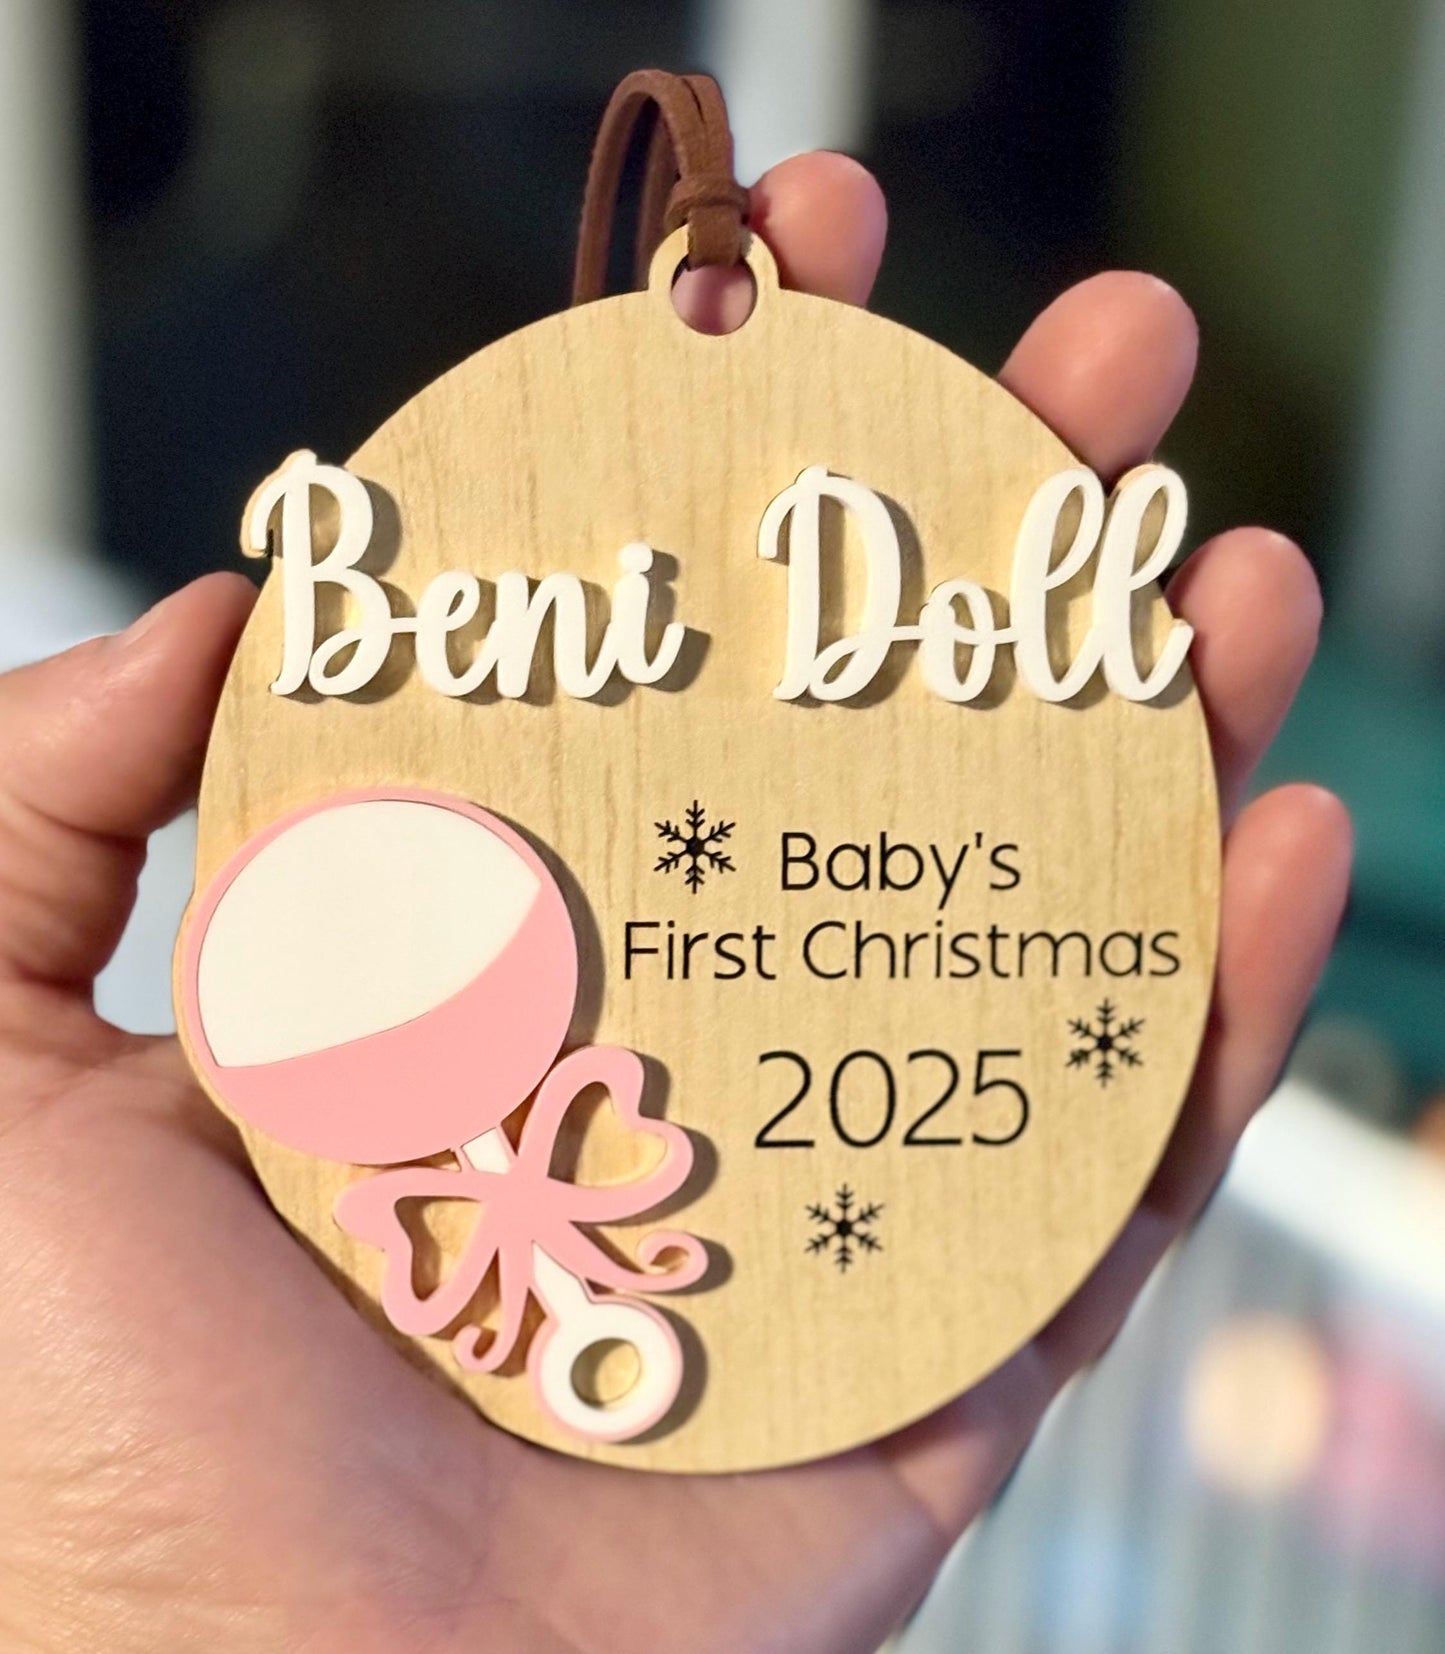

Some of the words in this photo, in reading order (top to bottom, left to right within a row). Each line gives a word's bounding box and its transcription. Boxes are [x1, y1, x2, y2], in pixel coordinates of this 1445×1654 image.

[249, 451, 684, 699] Beni
[759, 464, 1194, 703] Doll
[780, 831, 1021, 910] Baby's
[624, 921, 776, 980] First
[803, 920, 1181, 979] Christmas
[754, 1049, 1030, 1149] 2025
